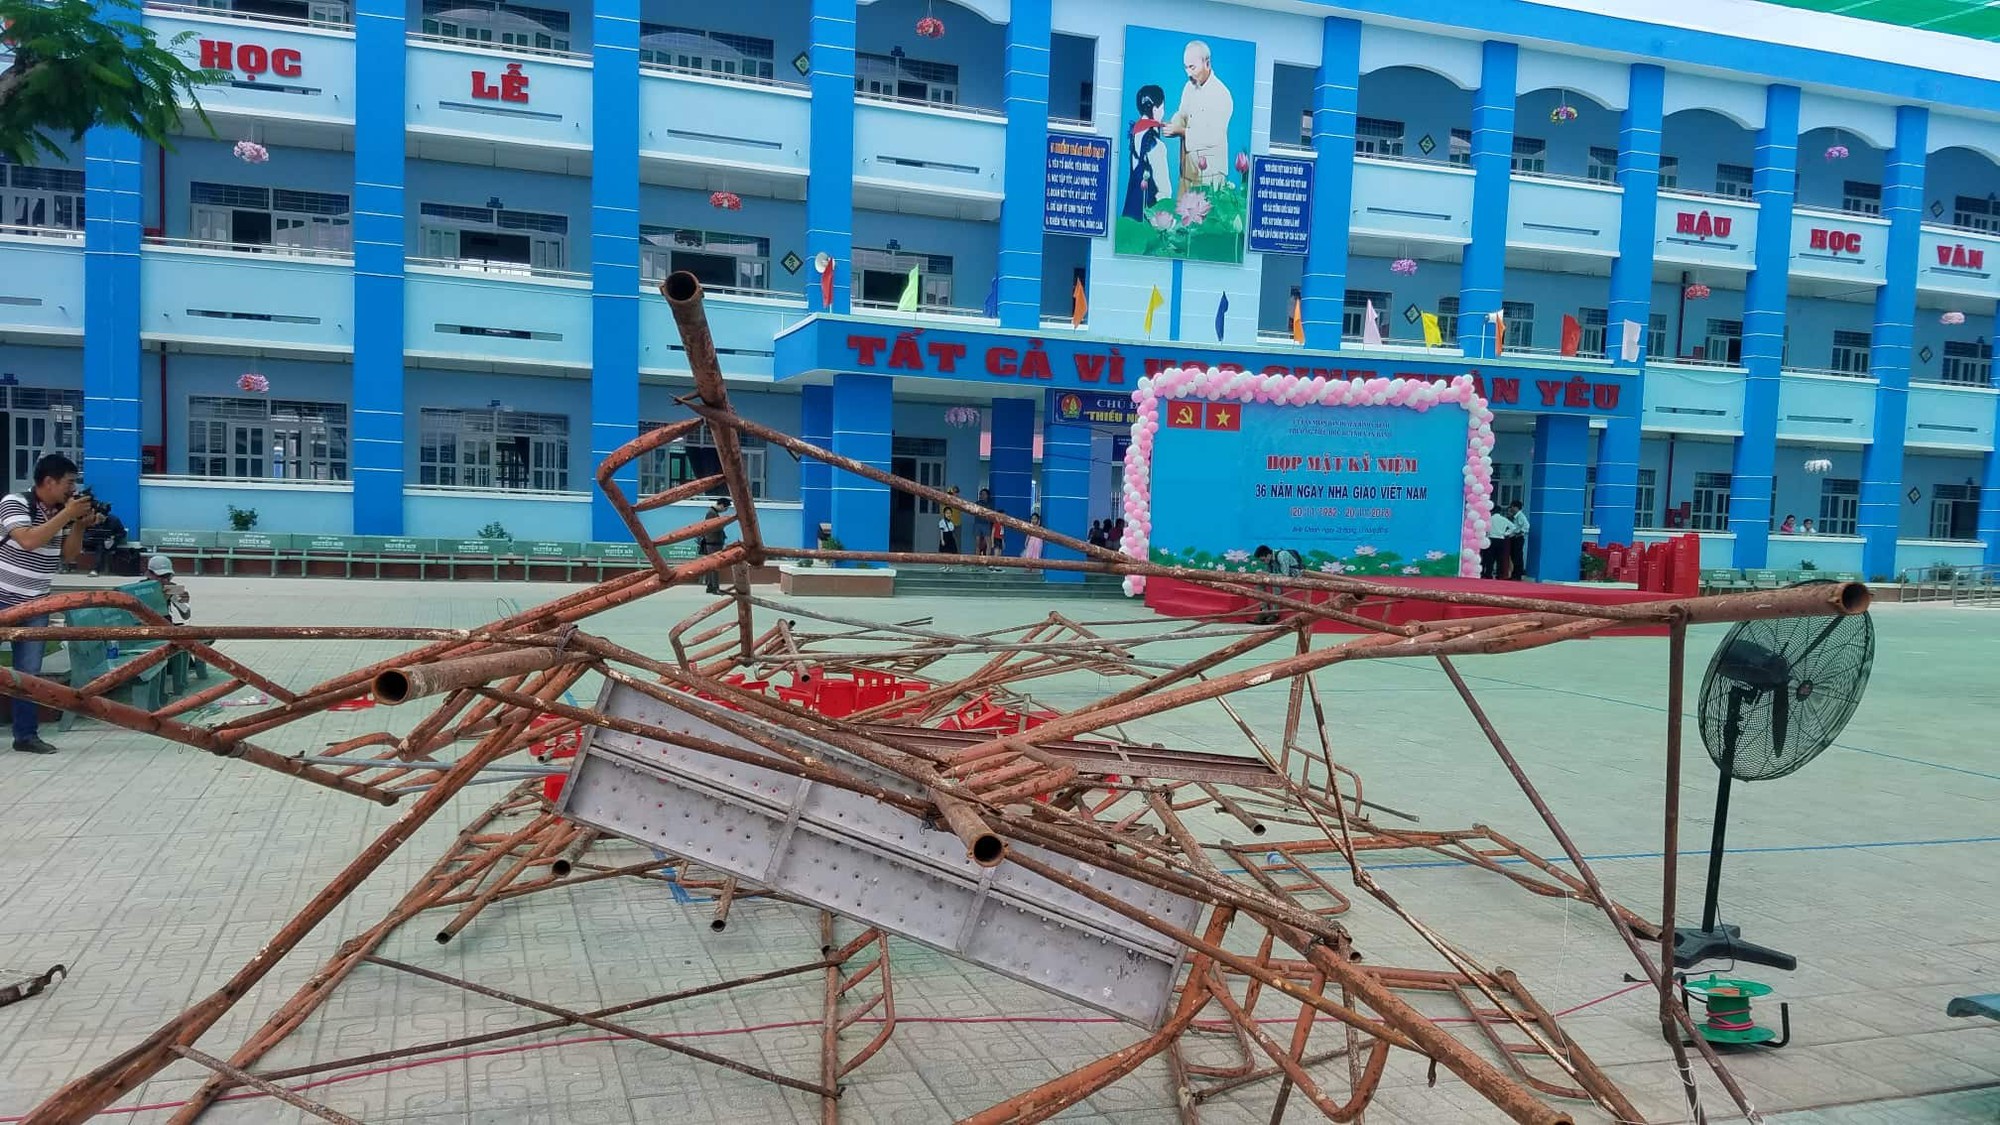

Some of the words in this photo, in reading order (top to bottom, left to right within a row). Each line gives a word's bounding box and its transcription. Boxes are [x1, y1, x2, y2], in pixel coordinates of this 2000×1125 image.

[199, 39, 302, 81] HỌC
[471, 63, 529, 104] LỄ
[1676, 211, 1732, 241] HẬU
[1810, 228, 1862, 256] HỌC
[1937, 244, 1984, 270] VĂN
[847, 328, 966, 373] TẤT
[985, 338, 1053, 379] CẢ
[1073, 347, 1125, 384] VÌ
[1537, 376, 1621, 409] YÊU
[1307, 452, 1344, 475] MẶT
[1377, 454, 1418, 476] NIỆM
[1255, 484, 1266, 498] 36
[1270, 479, 1293, 498] NĂM
[1406, 486, 1428, 501] NAM
